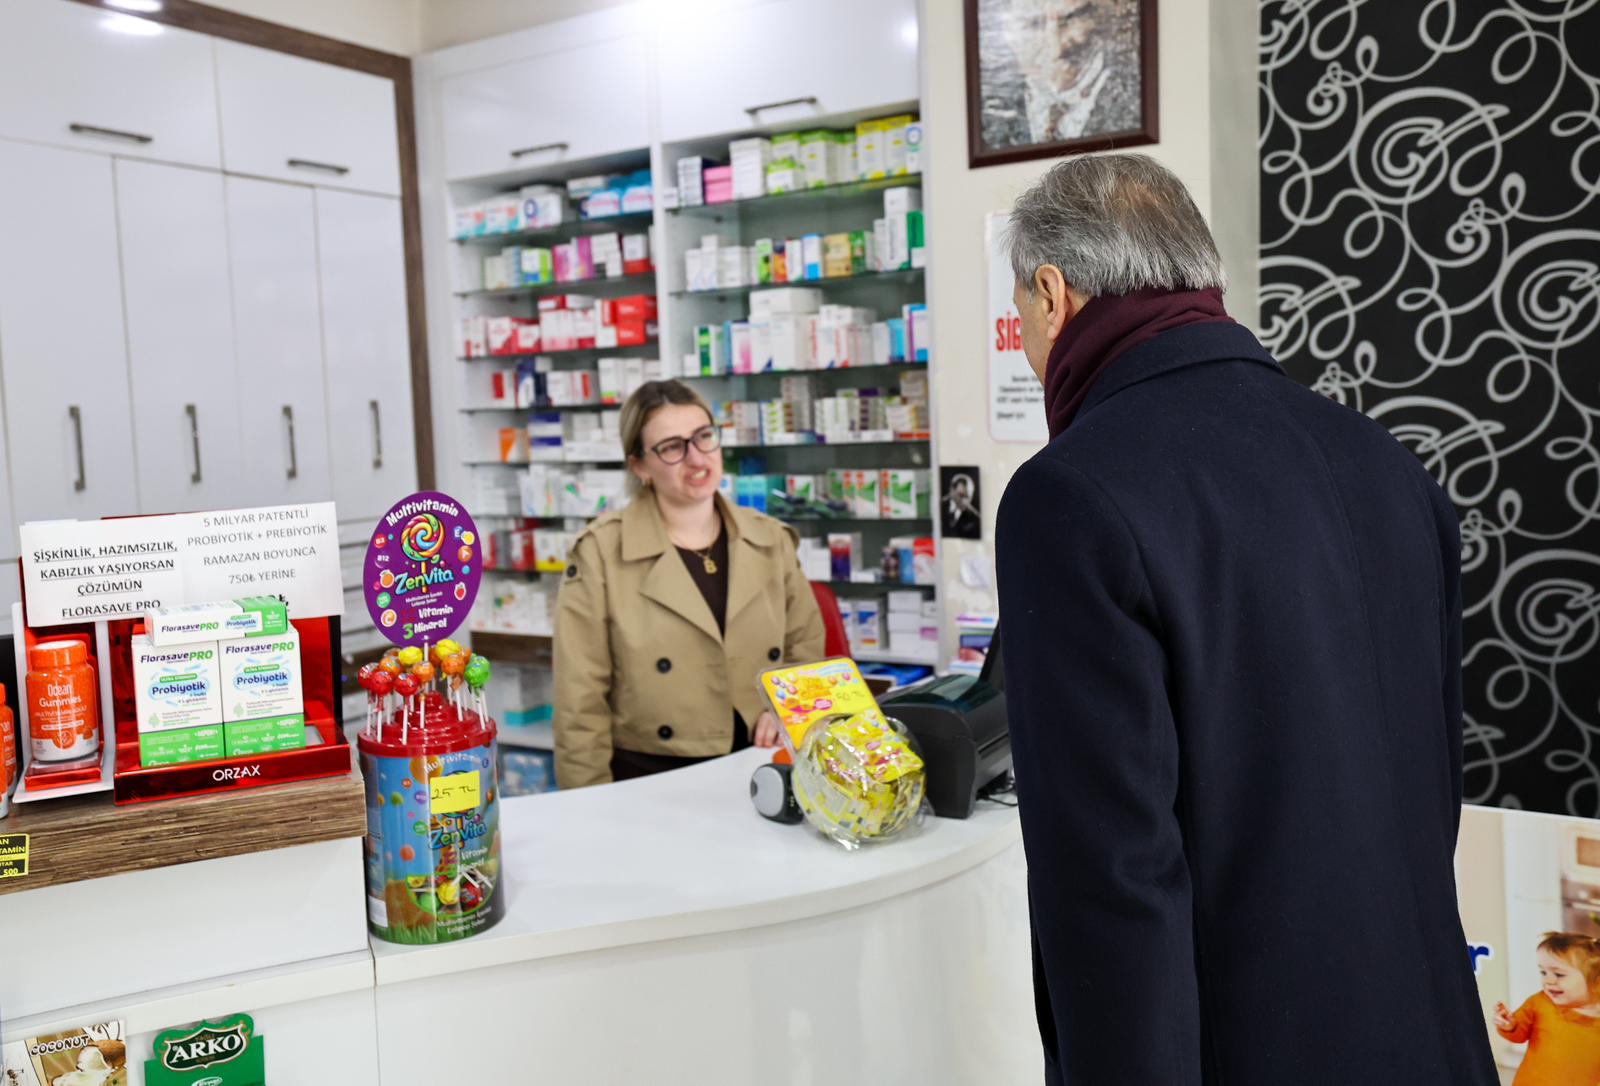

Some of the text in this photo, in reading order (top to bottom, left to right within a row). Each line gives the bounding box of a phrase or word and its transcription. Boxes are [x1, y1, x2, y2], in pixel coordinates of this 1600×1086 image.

[203, 507, 309, 527] 5 MİLYAR PATENTLİ
[385, 499, 459, 527] Multivitamin
[187, 531, 254, 546] PROBİYOTİK
[266, 524, 328, 539] PREBİYOTİK
[33, 540, 178, 563] ŞİŞKİNLİK, HAZIMSIZLIK,
[203, 546, 317, 566] RAMAZAN BOYUNCA
[377, 554, 390, 562] B12
[40, 559, 175, 579] KABIZLIK YAŞIYORSAN
[258, 568, 297, 581] YERİNE
[77, 578, 143, 596] ÇÖZÜMÜN
[62, 602, 133, 618] FLORASAVE
[136, 599, 161, 611] PRO
[418, 604, 454, 619] Vitamin
[402, 617, 447, 640] 3 Mineral
[152, 681, 206, 695] Probiyotik
[236, 672, 288, 686] Probiyotik
[48, 684, 72, 697] Ocean
[39, 696, 82, 708] Gummies
[424, 752, 482, 774] Multivitamin
[212, 764, 261, 782] ORZAX
[431, 787, 454, 801] 25
[458, 786, 476, 794] TL
[31, 1035, 91, 1056] COCONUT
[169, 1033, 241, 1064] ARKO
